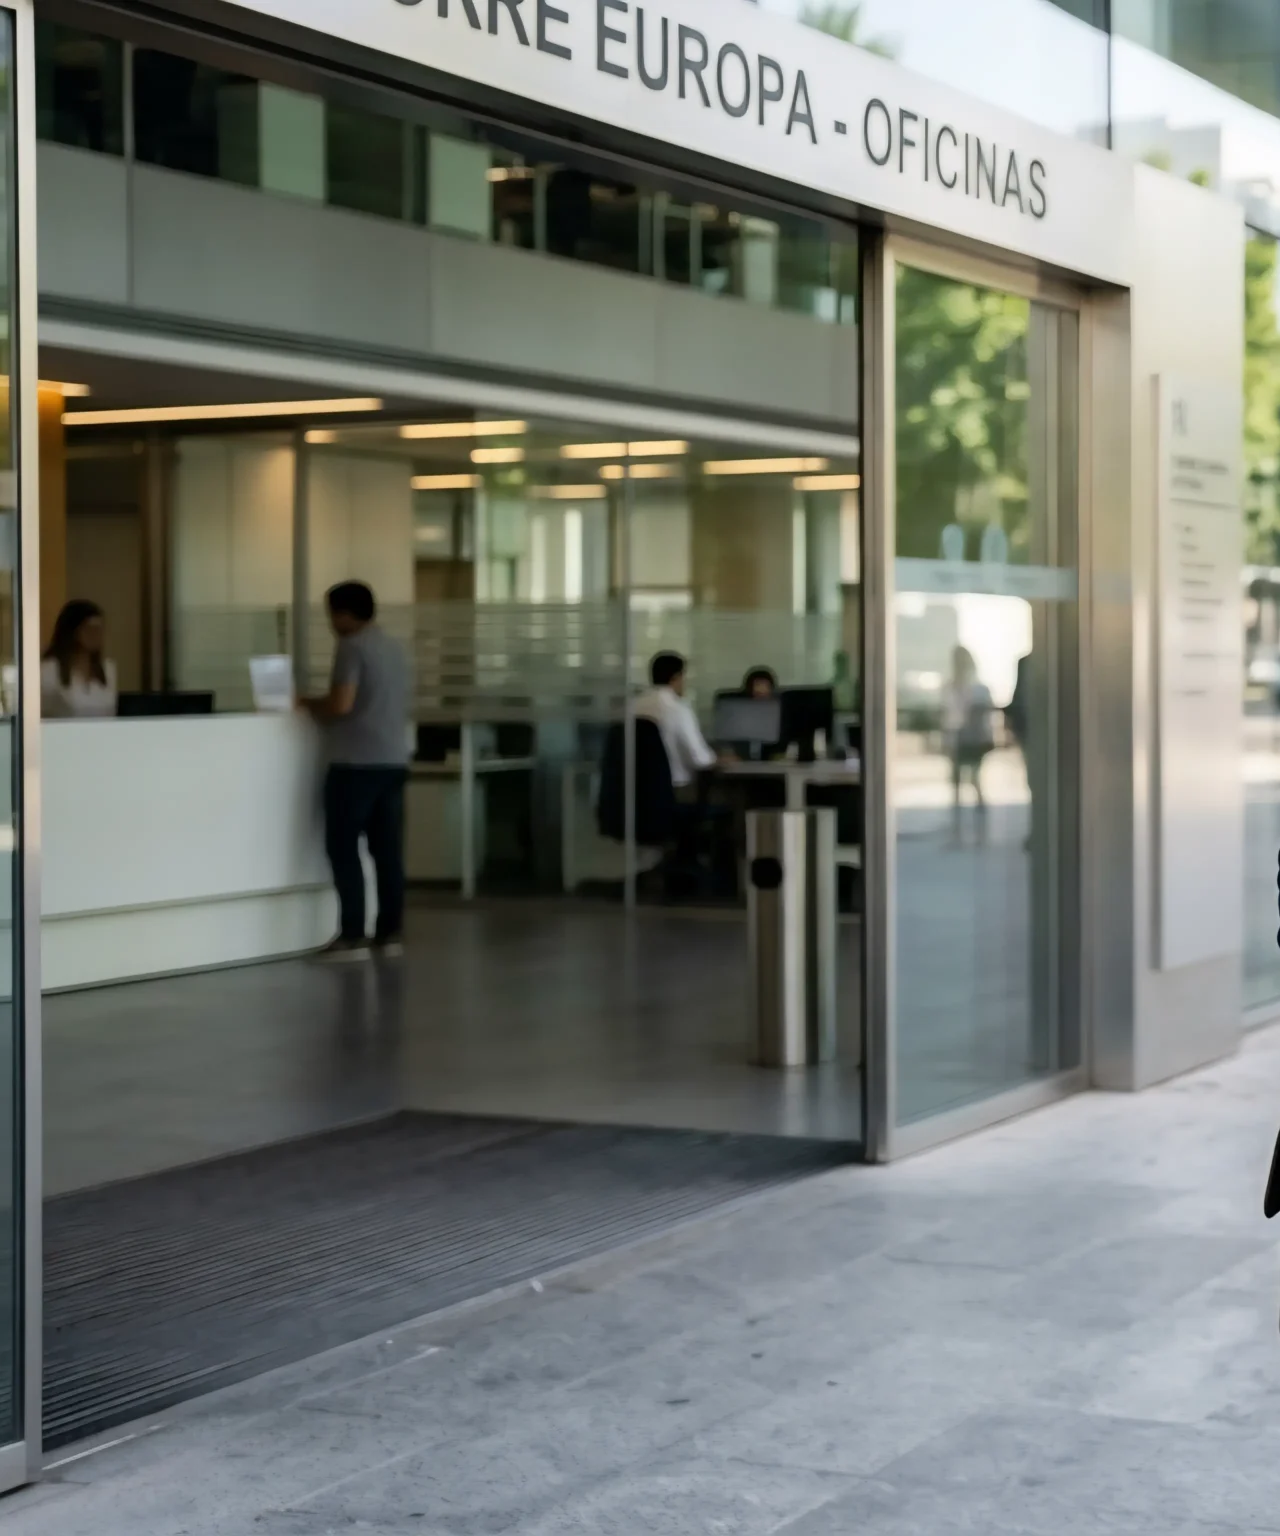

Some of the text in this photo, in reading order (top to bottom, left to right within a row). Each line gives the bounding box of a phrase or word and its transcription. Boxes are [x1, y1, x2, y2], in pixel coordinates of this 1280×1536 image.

[597, 0, 817, 144] EUROPA
[834, 120, 847, 135] -
[864, 98, 1046, 219] OFICINAS
